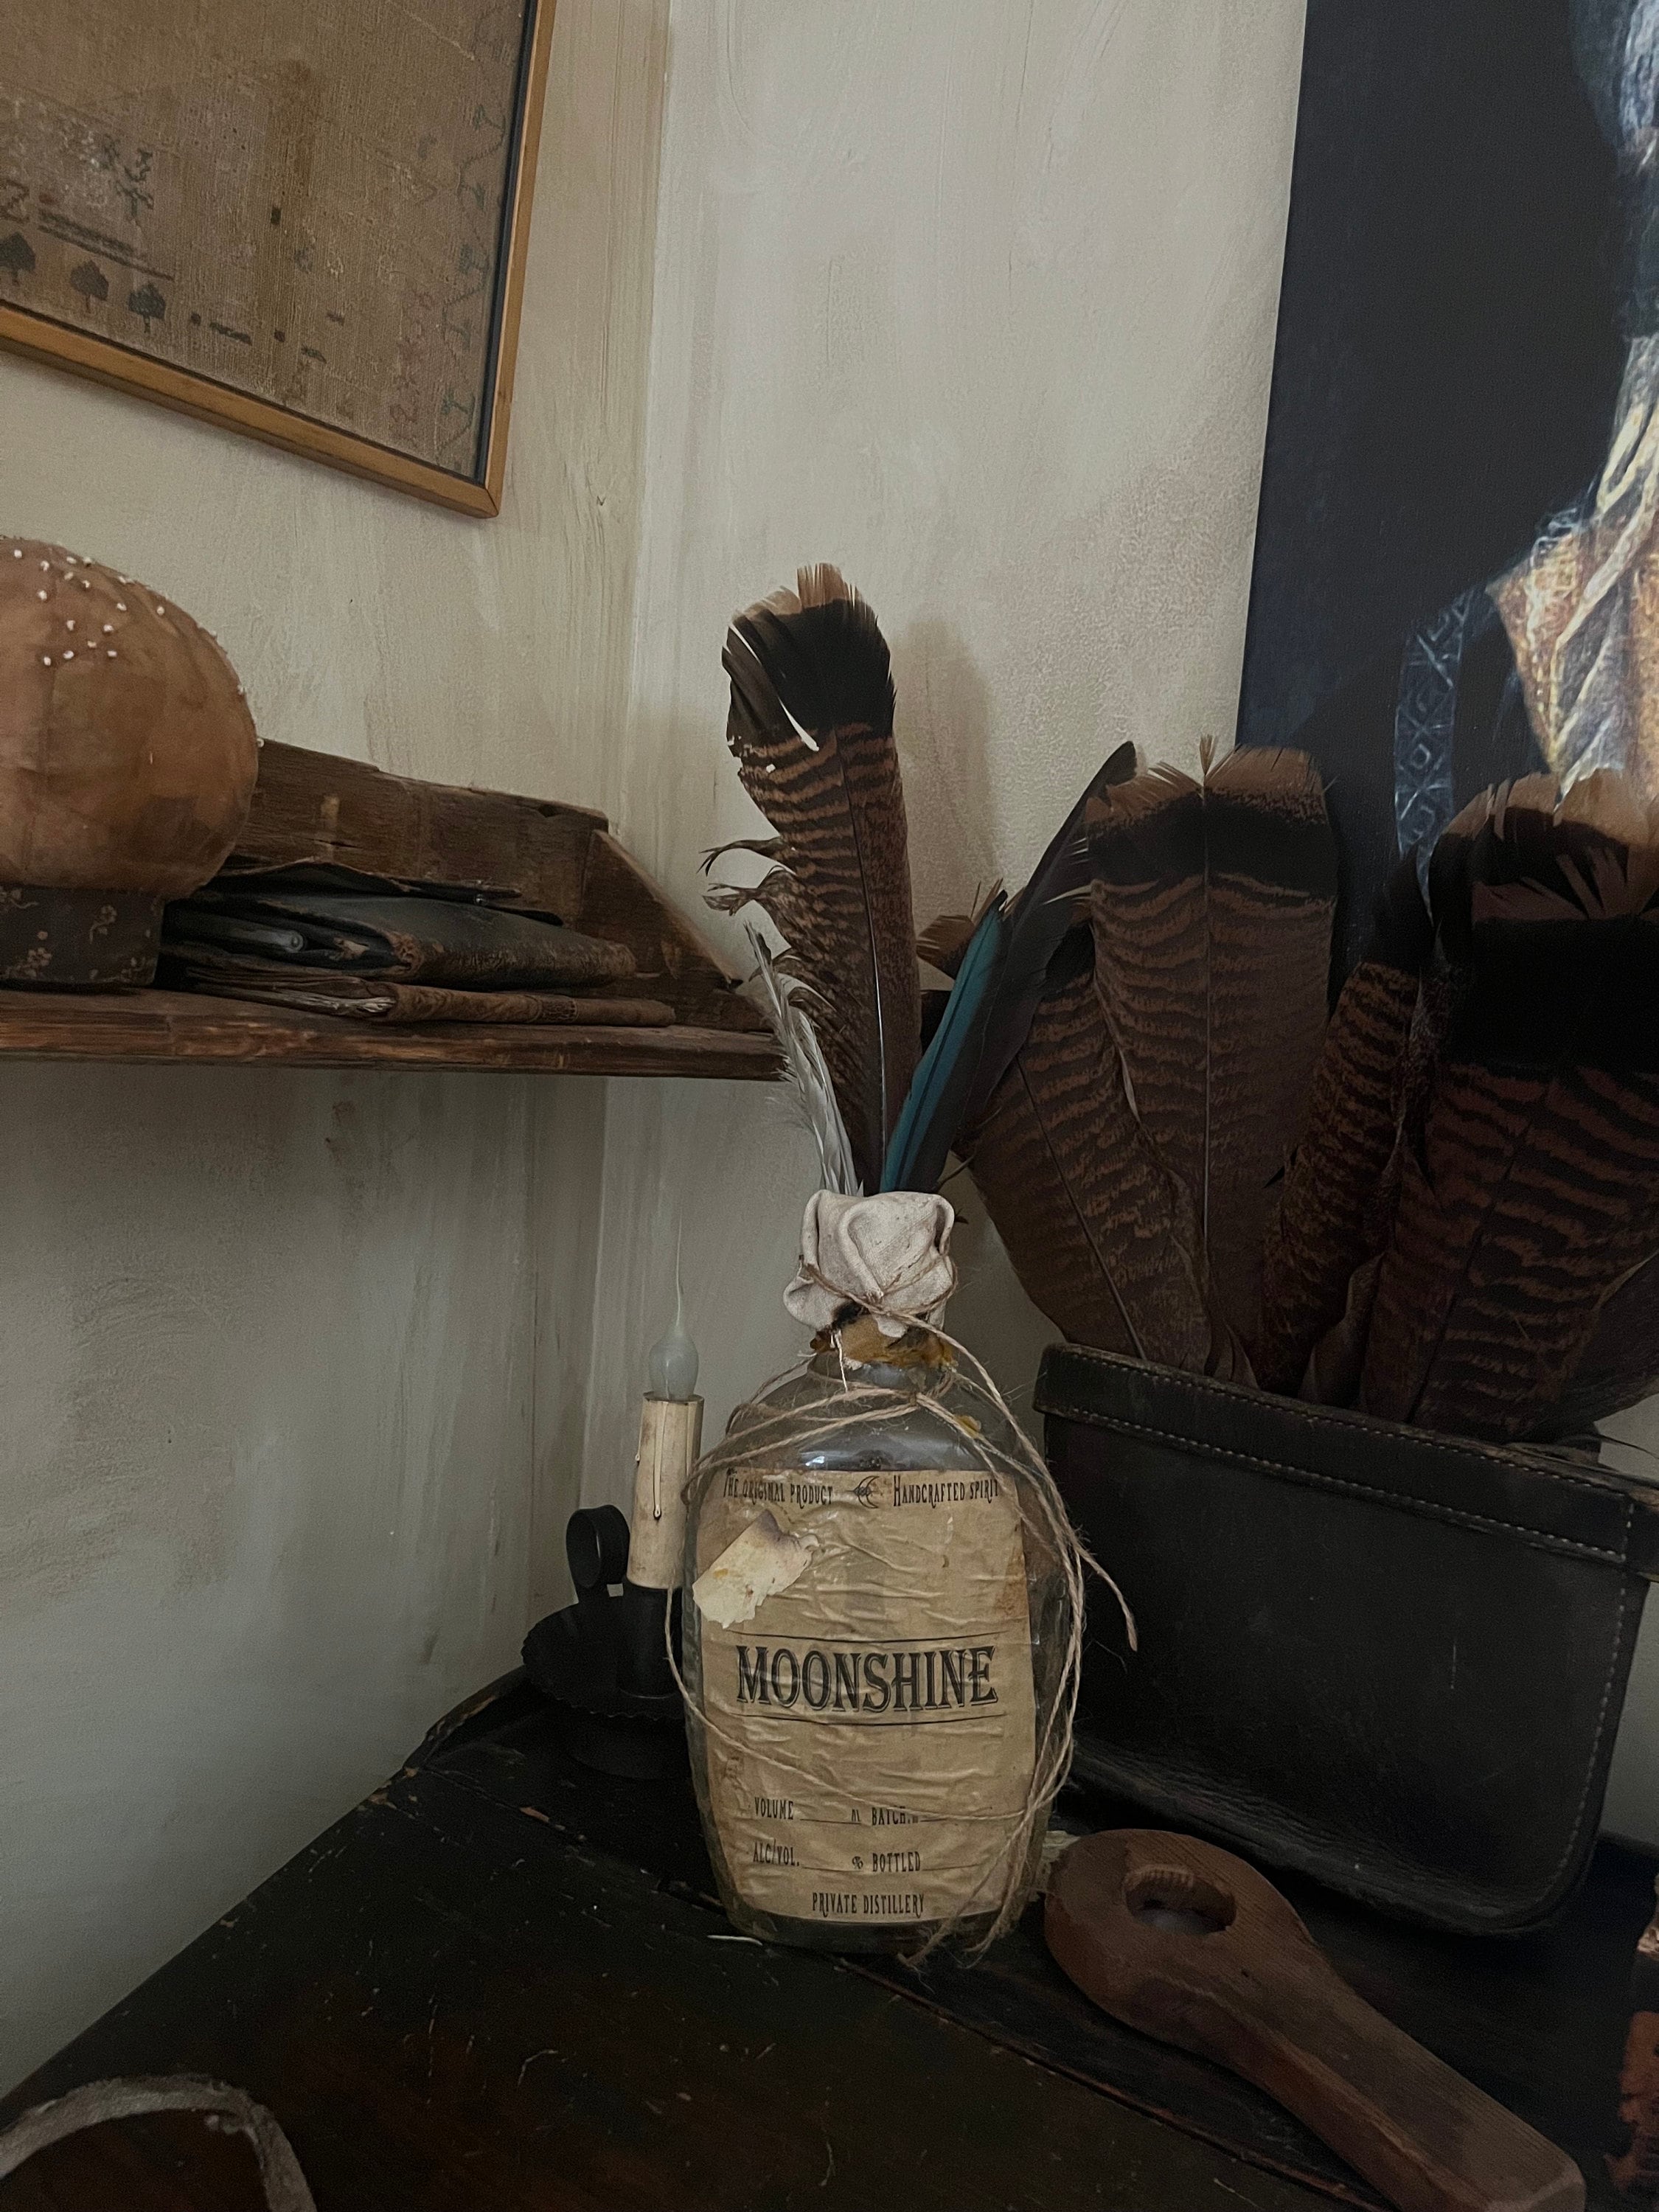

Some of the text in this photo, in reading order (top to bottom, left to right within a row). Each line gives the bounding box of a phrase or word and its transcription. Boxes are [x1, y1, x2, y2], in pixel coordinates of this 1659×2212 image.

[742, 1480, 785, 1505] ORIGINAL
[790, 1484, 833, 1509] PRODUCT
[893, 1475, 965, 1509] HANDCRAFTED
[736, 1645, 999, 1712] MOONSHINE
[754, 1797, 793, 1820] VOLUME
[753, 1839, 800, 1866] ALC/VOL.
[872, 1851, 921, 1872] BOTTLED
[813, 1892, 925, 1919] PRIVATE DISTILLERY
